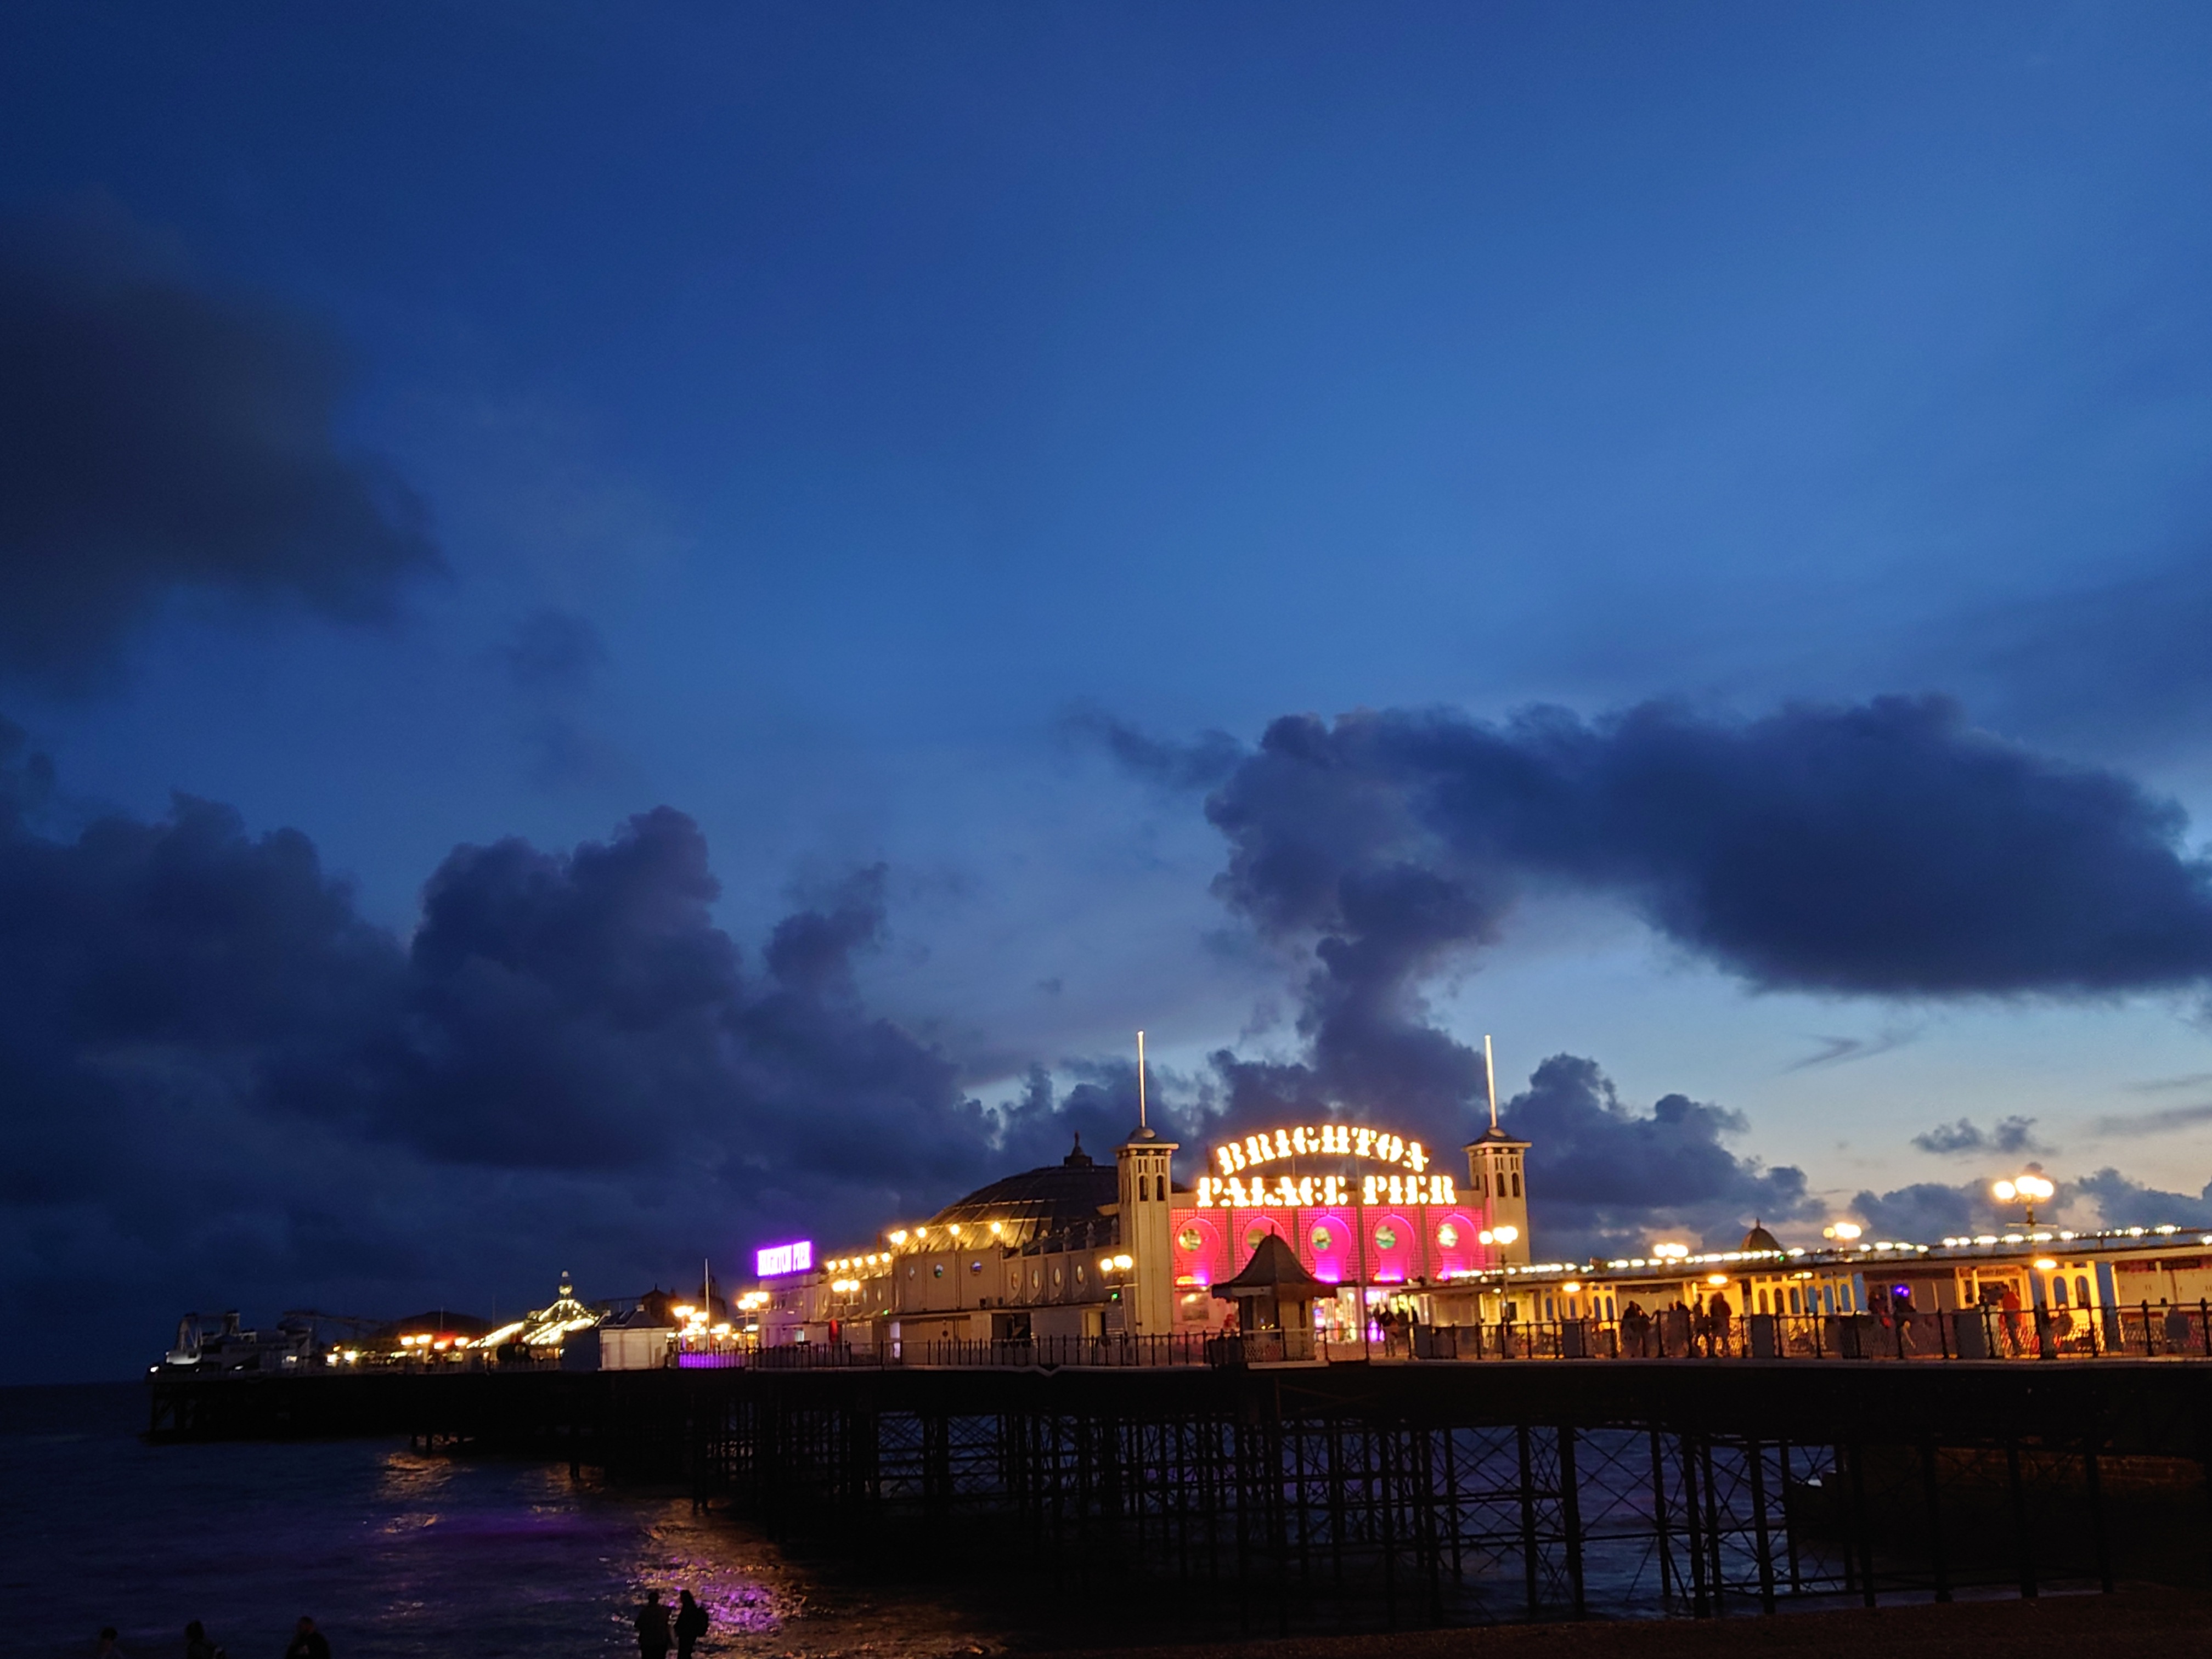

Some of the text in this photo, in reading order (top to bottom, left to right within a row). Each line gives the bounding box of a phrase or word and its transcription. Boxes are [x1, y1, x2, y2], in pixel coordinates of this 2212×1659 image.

[1216, 1124, 1430, 1176] BRIGHTON
[1197, 1175, 1457, 1207] PALACE PIER
